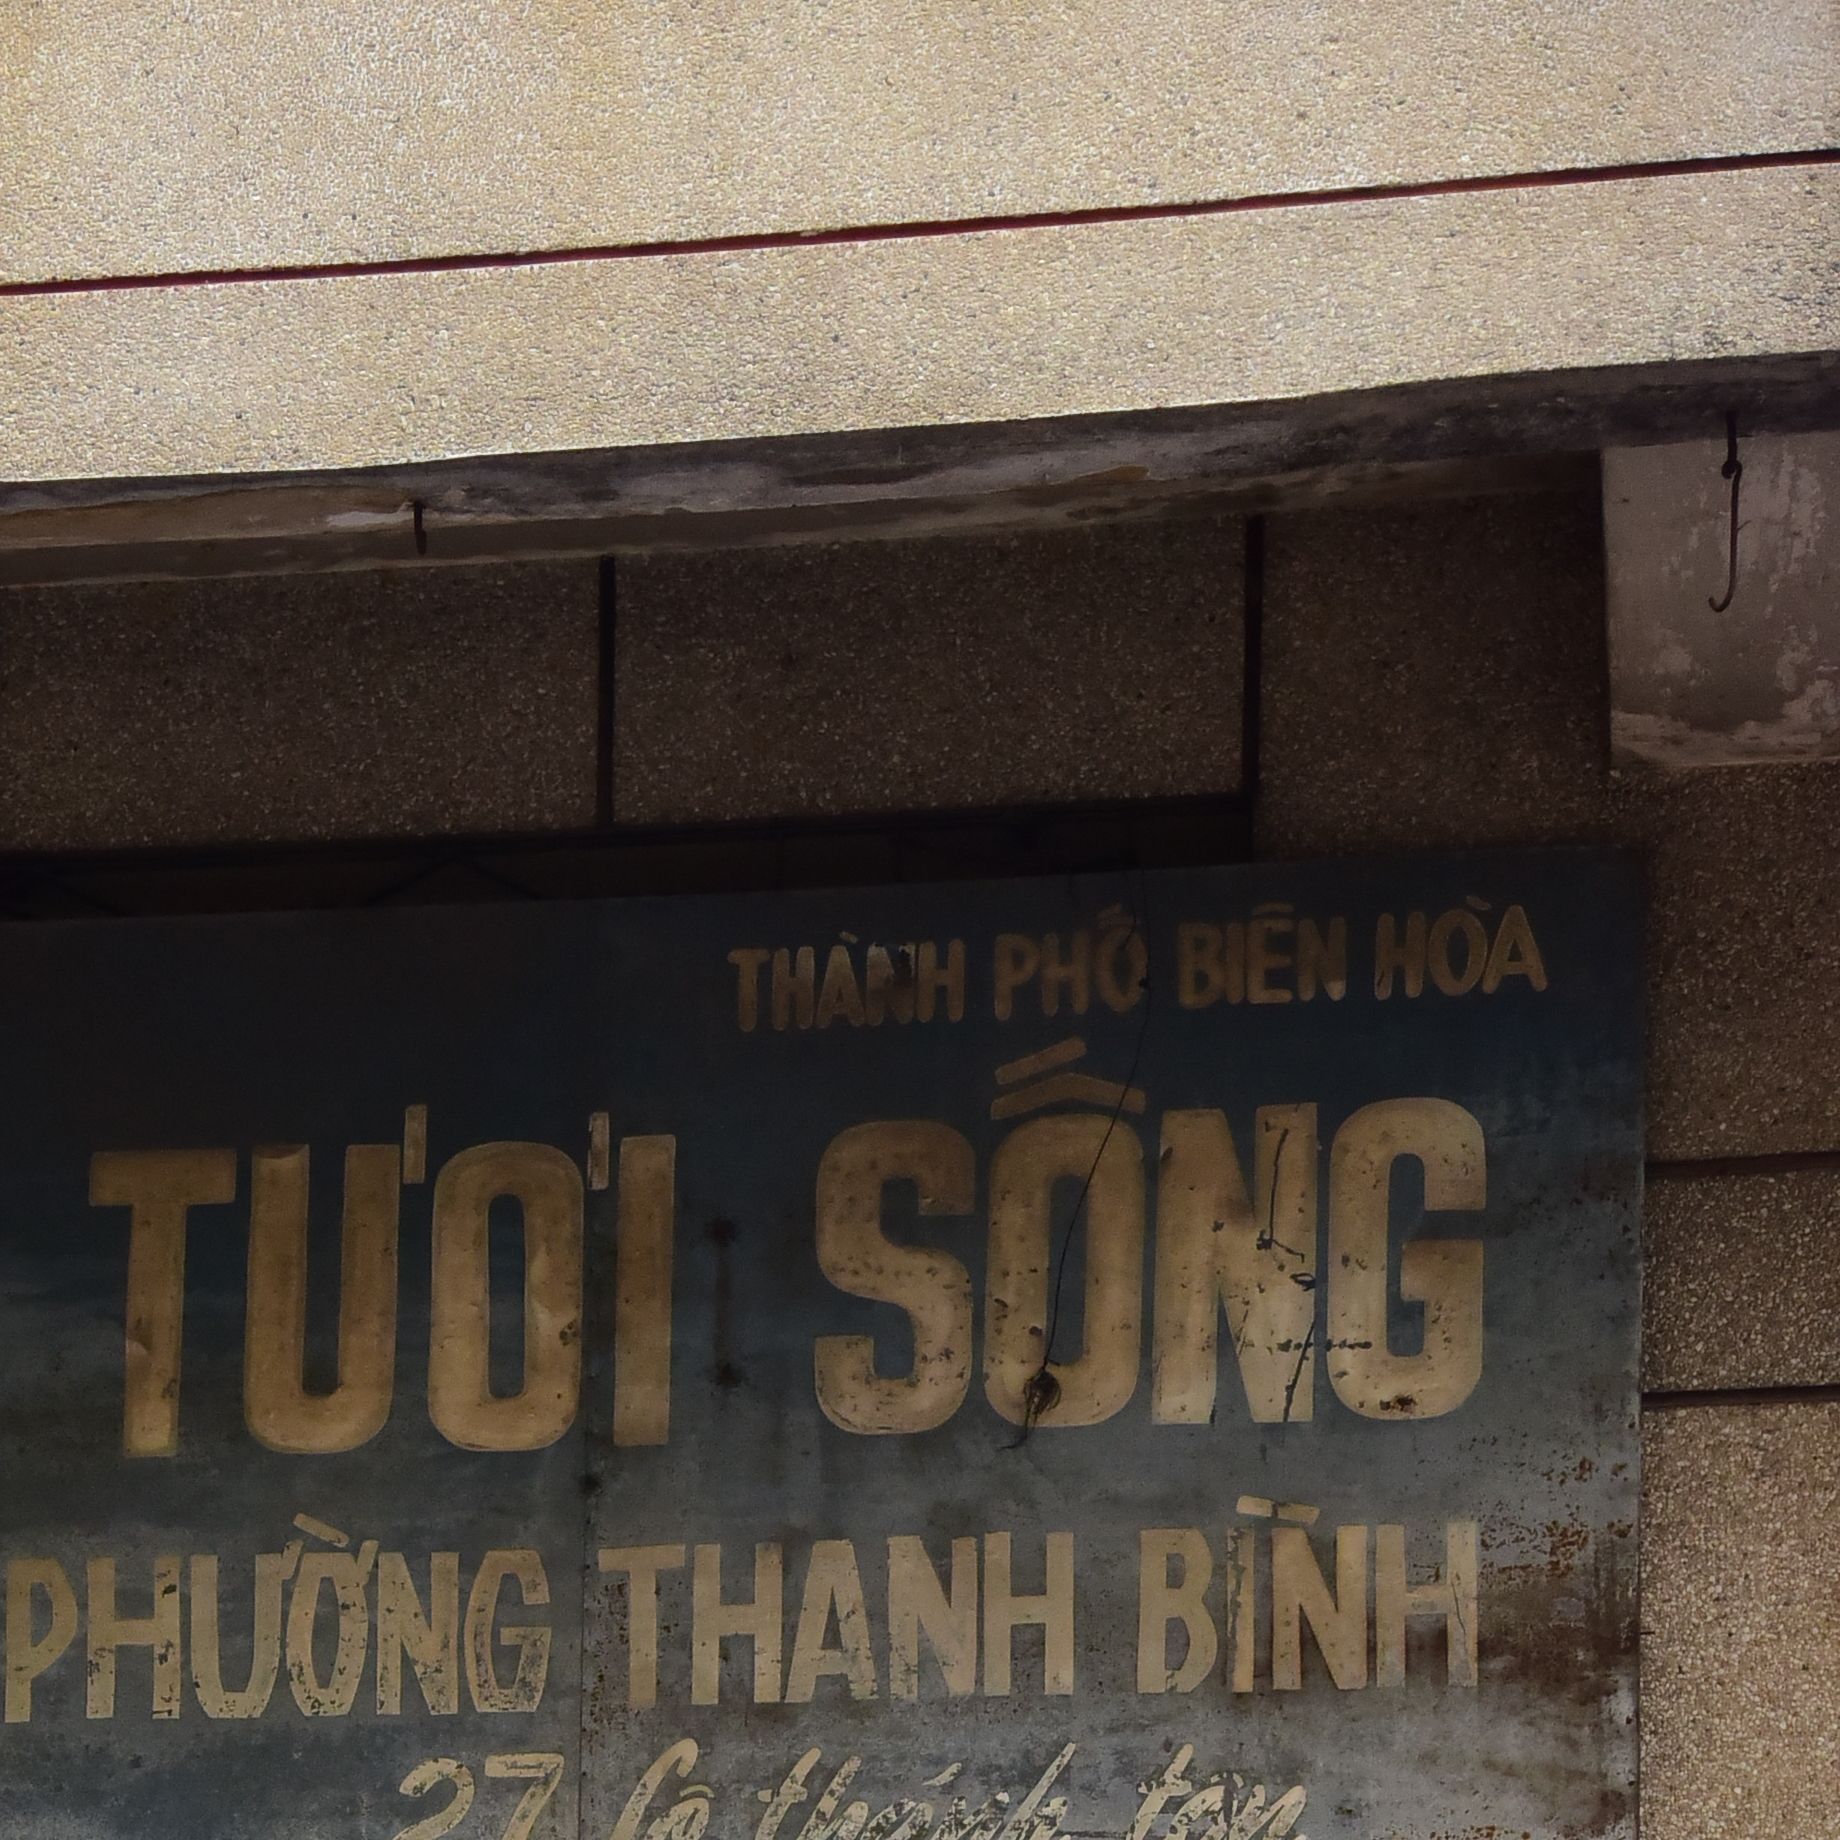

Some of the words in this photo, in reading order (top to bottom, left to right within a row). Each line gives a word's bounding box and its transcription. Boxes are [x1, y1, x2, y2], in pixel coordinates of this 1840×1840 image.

[727, 931, 964, 1033] THÀNH
[1177, 902, 1347, 1009] BIÊN
[90, 1104, 676, 1459] TƯƠI
[814, 1036, 1488, 1438] SỐNG
[4, 1511, 552, 1723] PHƯỜNG
[598, 1527, 1077, 1711] THANH
[1136, 1495, 1482, 1696] BÌNH
